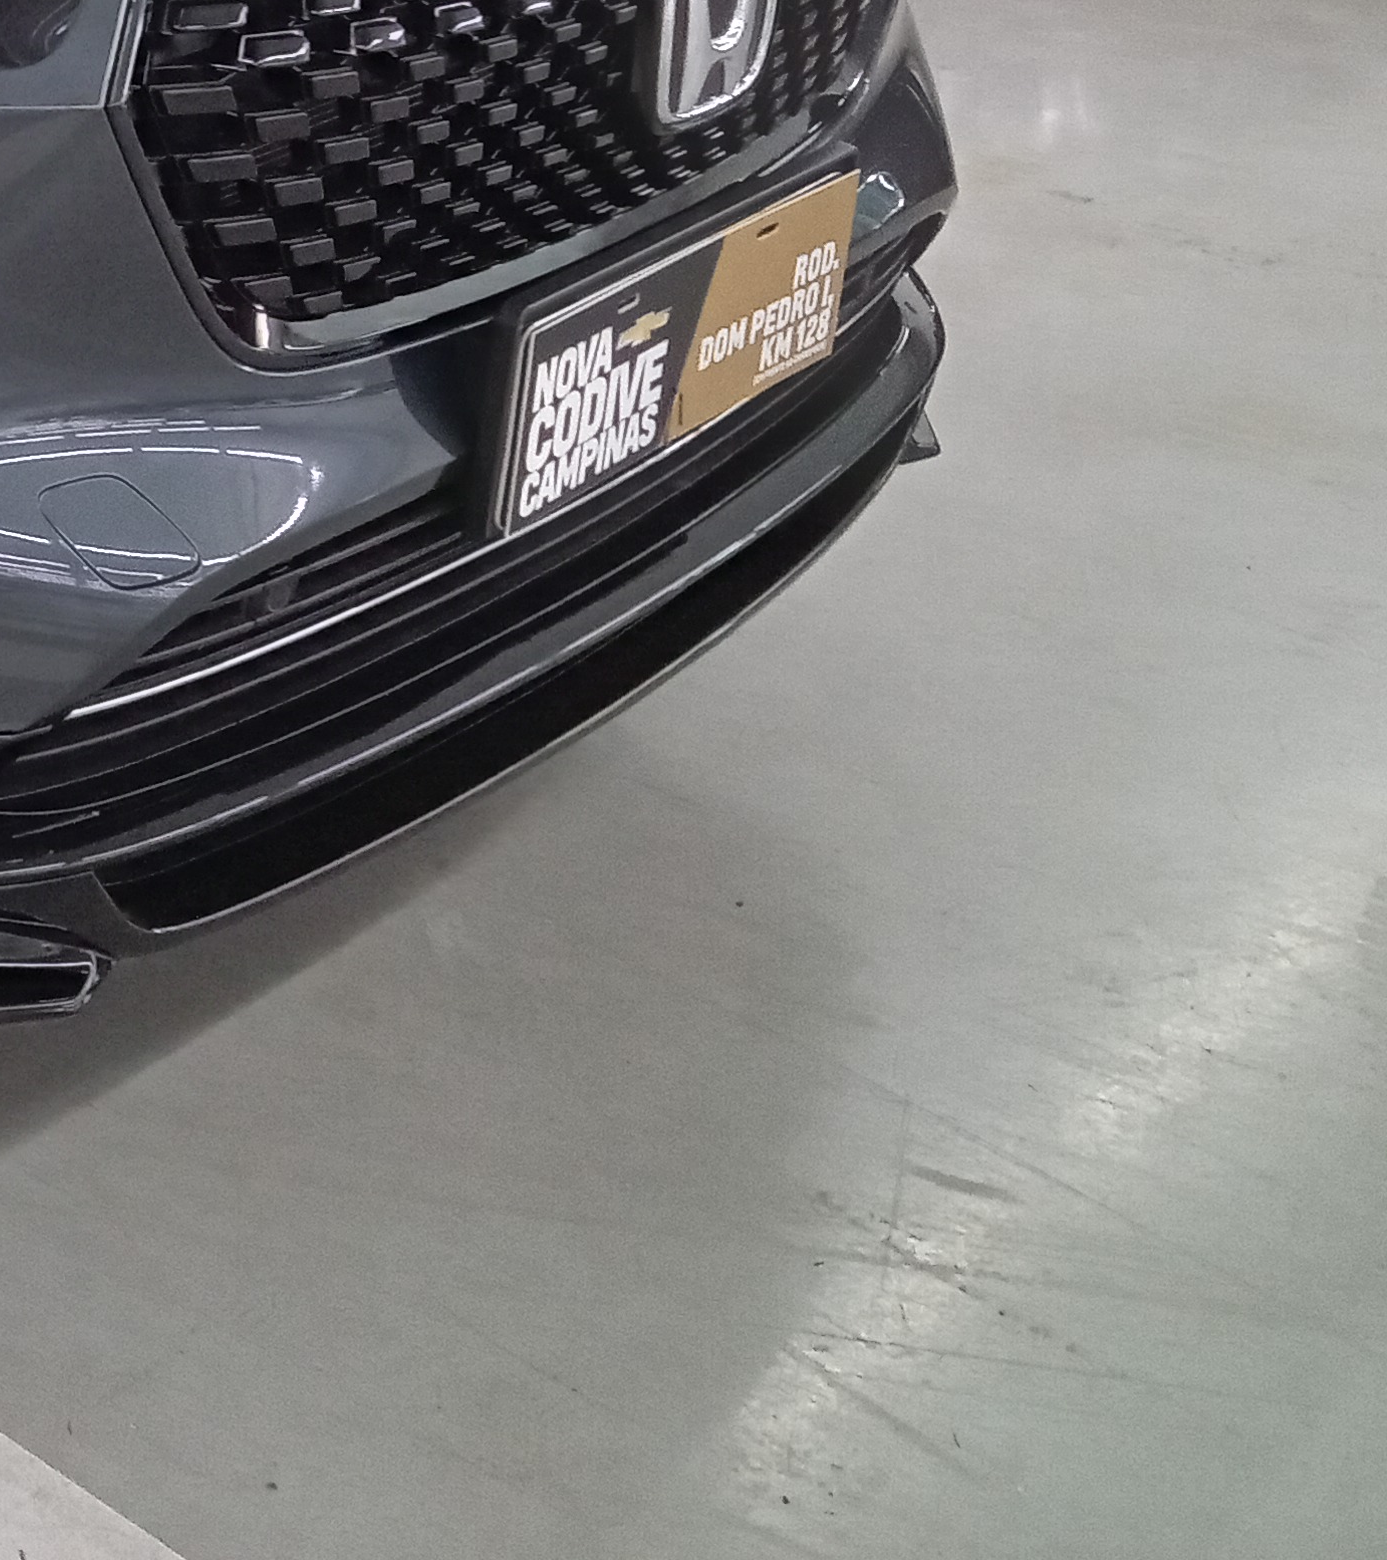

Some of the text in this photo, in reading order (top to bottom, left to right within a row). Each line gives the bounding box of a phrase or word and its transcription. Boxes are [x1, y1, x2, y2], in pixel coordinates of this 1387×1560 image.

[793, 241, 840, 290] ROD.
[532, 326, 614, 413] NOVA
[697, 316, 748, 371] DOM
[749, 281, 820, 345] PEDRO
[759, 326, 793, 371] KM
[796, 308, 831, 352] 128
[525, 339, 669, 474] CODIVE
[518, 403, 658, 517] CAMPINAS
